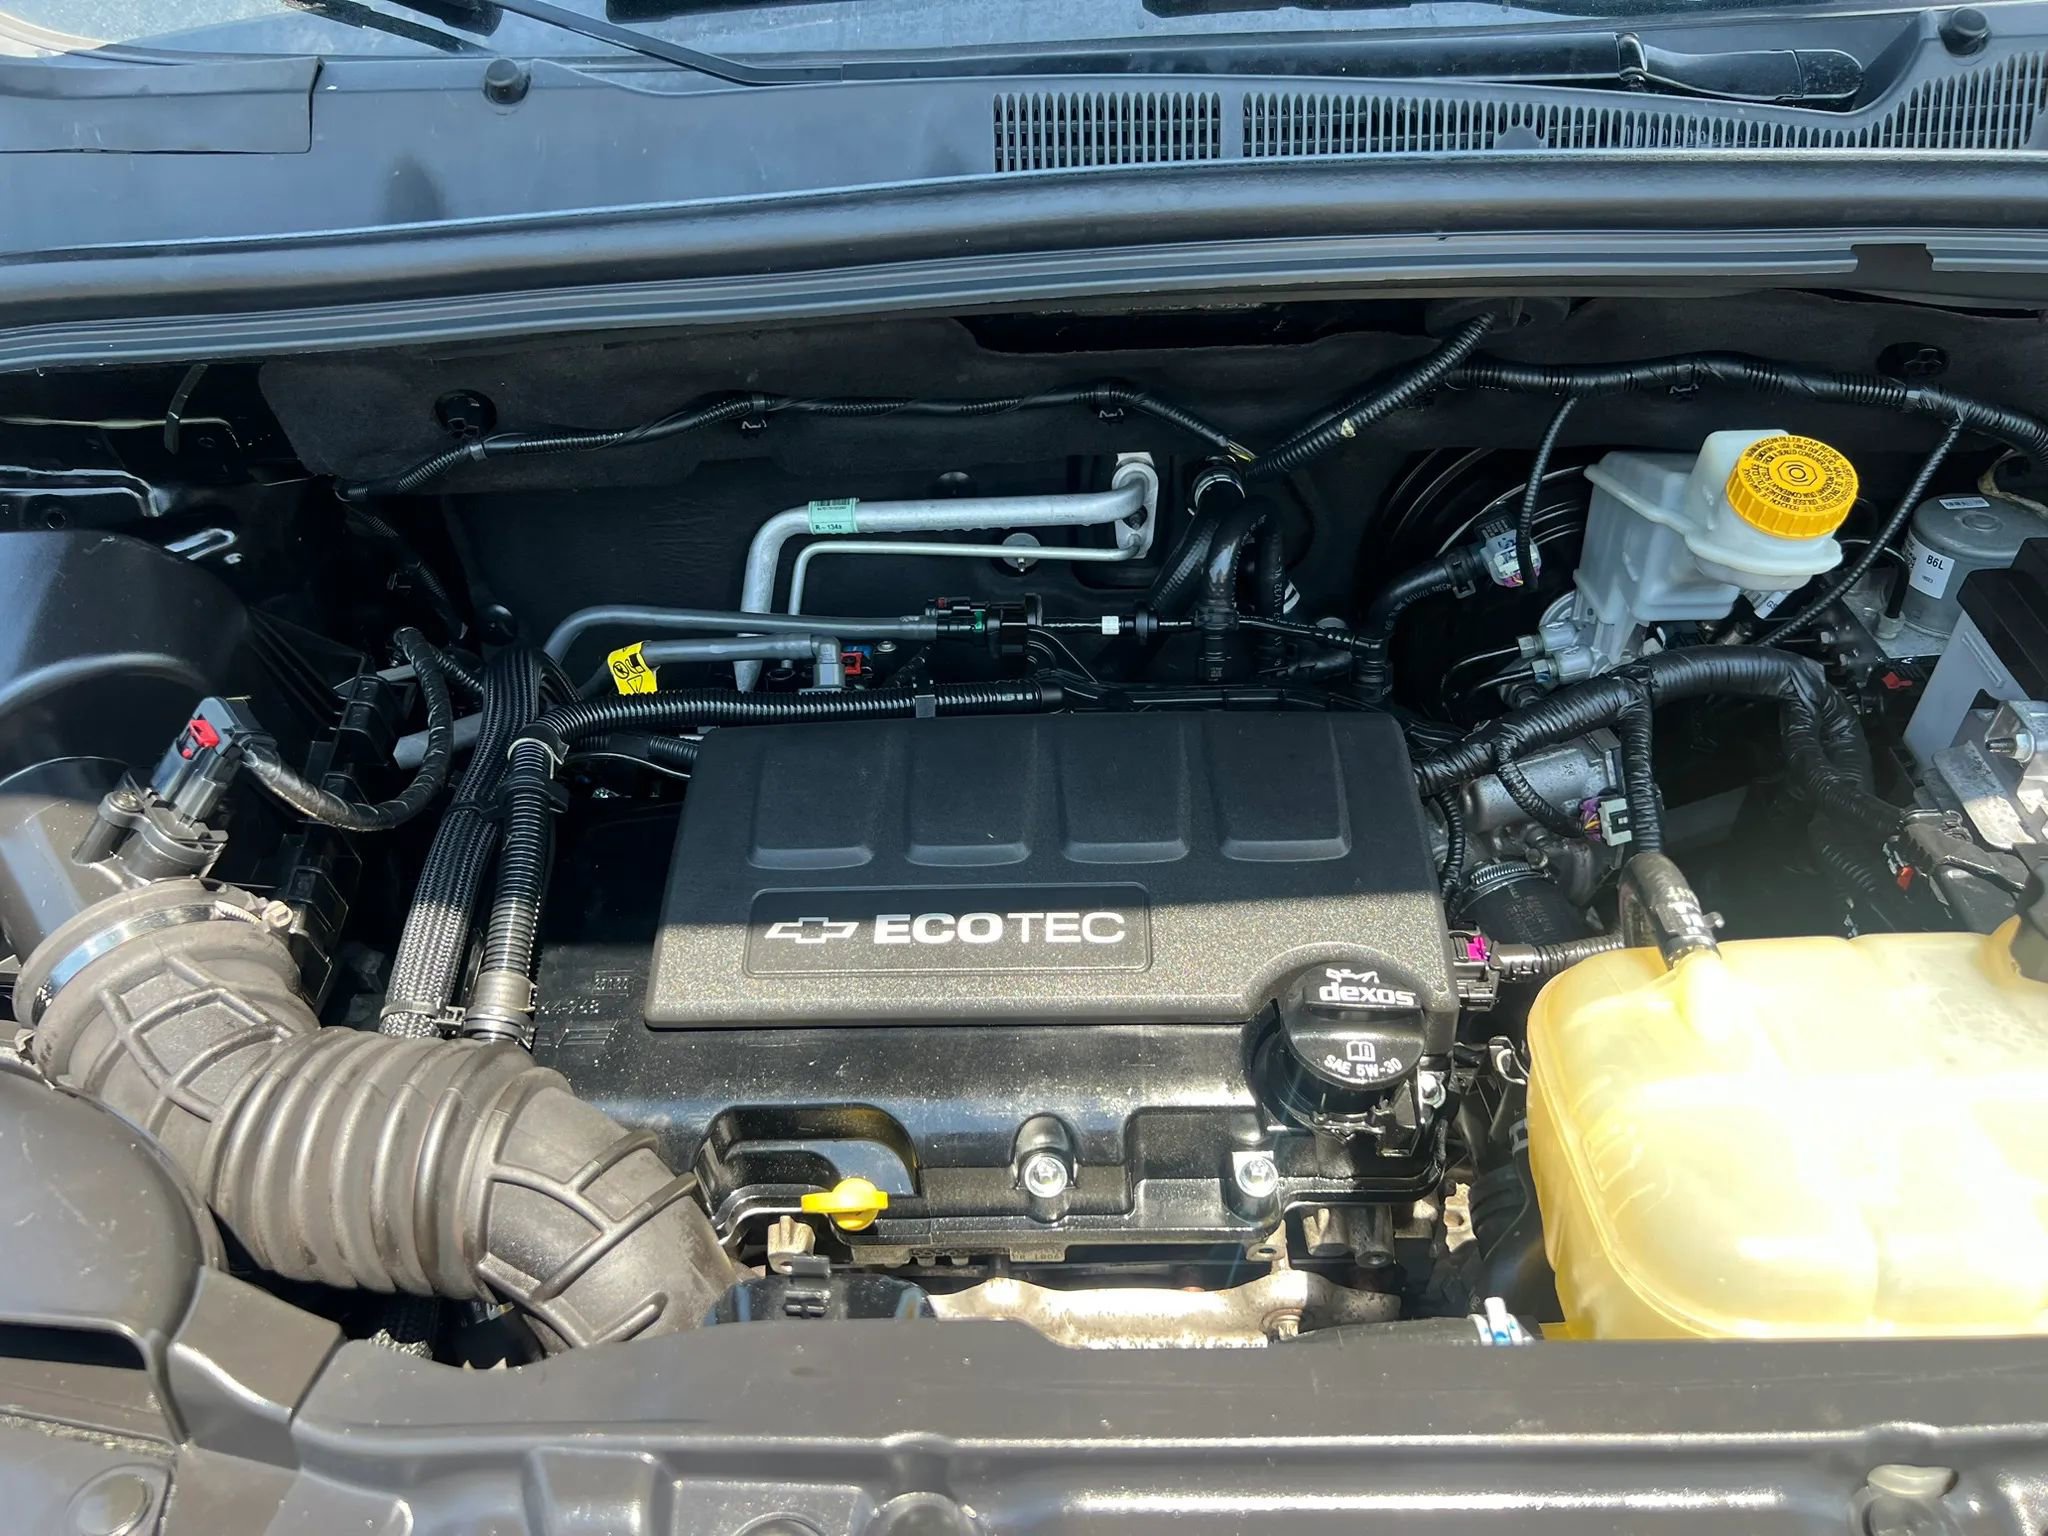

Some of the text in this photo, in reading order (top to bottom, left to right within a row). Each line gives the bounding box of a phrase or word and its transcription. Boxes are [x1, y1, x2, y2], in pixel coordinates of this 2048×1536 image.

[1926, 555, 1944, 570] B6L
[873, 911, 1126, 944] ECOTEC
[1319, 982, 1416, 1006] dexos
[1324, 1054, 1403, 1077] SAE 5W-30
